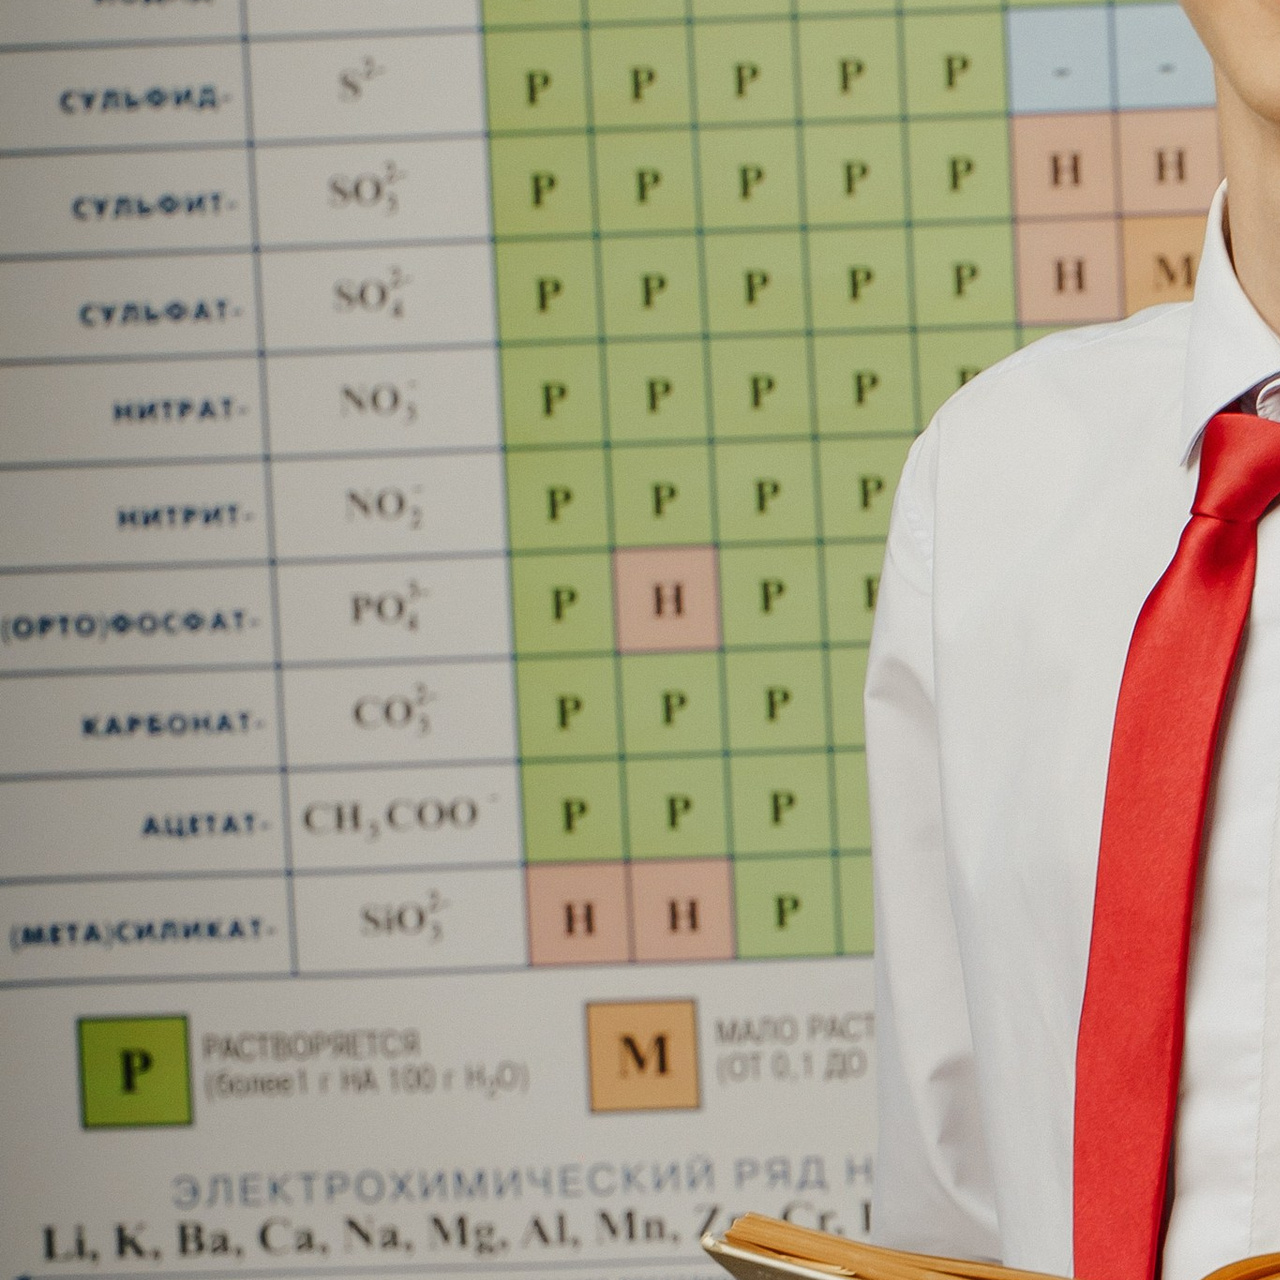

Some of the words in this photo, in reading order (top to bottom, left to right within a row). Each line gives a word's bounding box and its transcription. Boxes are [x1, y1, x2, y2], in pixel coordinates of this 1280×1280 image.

[531, 172, 557, 209] Р
[636, 169, 662, 204] Р
[739, 165, 765, 200] Р
[844, 161, 869, 196] Р
[949, 157, 975, 192] Р
[1050, 152, 1082, 188] Н
[1156, 149, 1186, 183] Н
[563, 900, 597, 939] Н
[667, 898, 700, 934] Н
[774, 894, 801, 930] Р
[203, 1028, 421, 1063] РАСТВОРЯЕТСЯ
[715, 1013, 800, 1046] МАЛО
[120, 1048, 154, 1096] Р
[618, 1033, 670, 1080] М
[172, 1157, 716, 1208] ЭЛЕКТРОХИМИЧЕСКИЙ
[735, 1158, 828, 1198] РЯД
